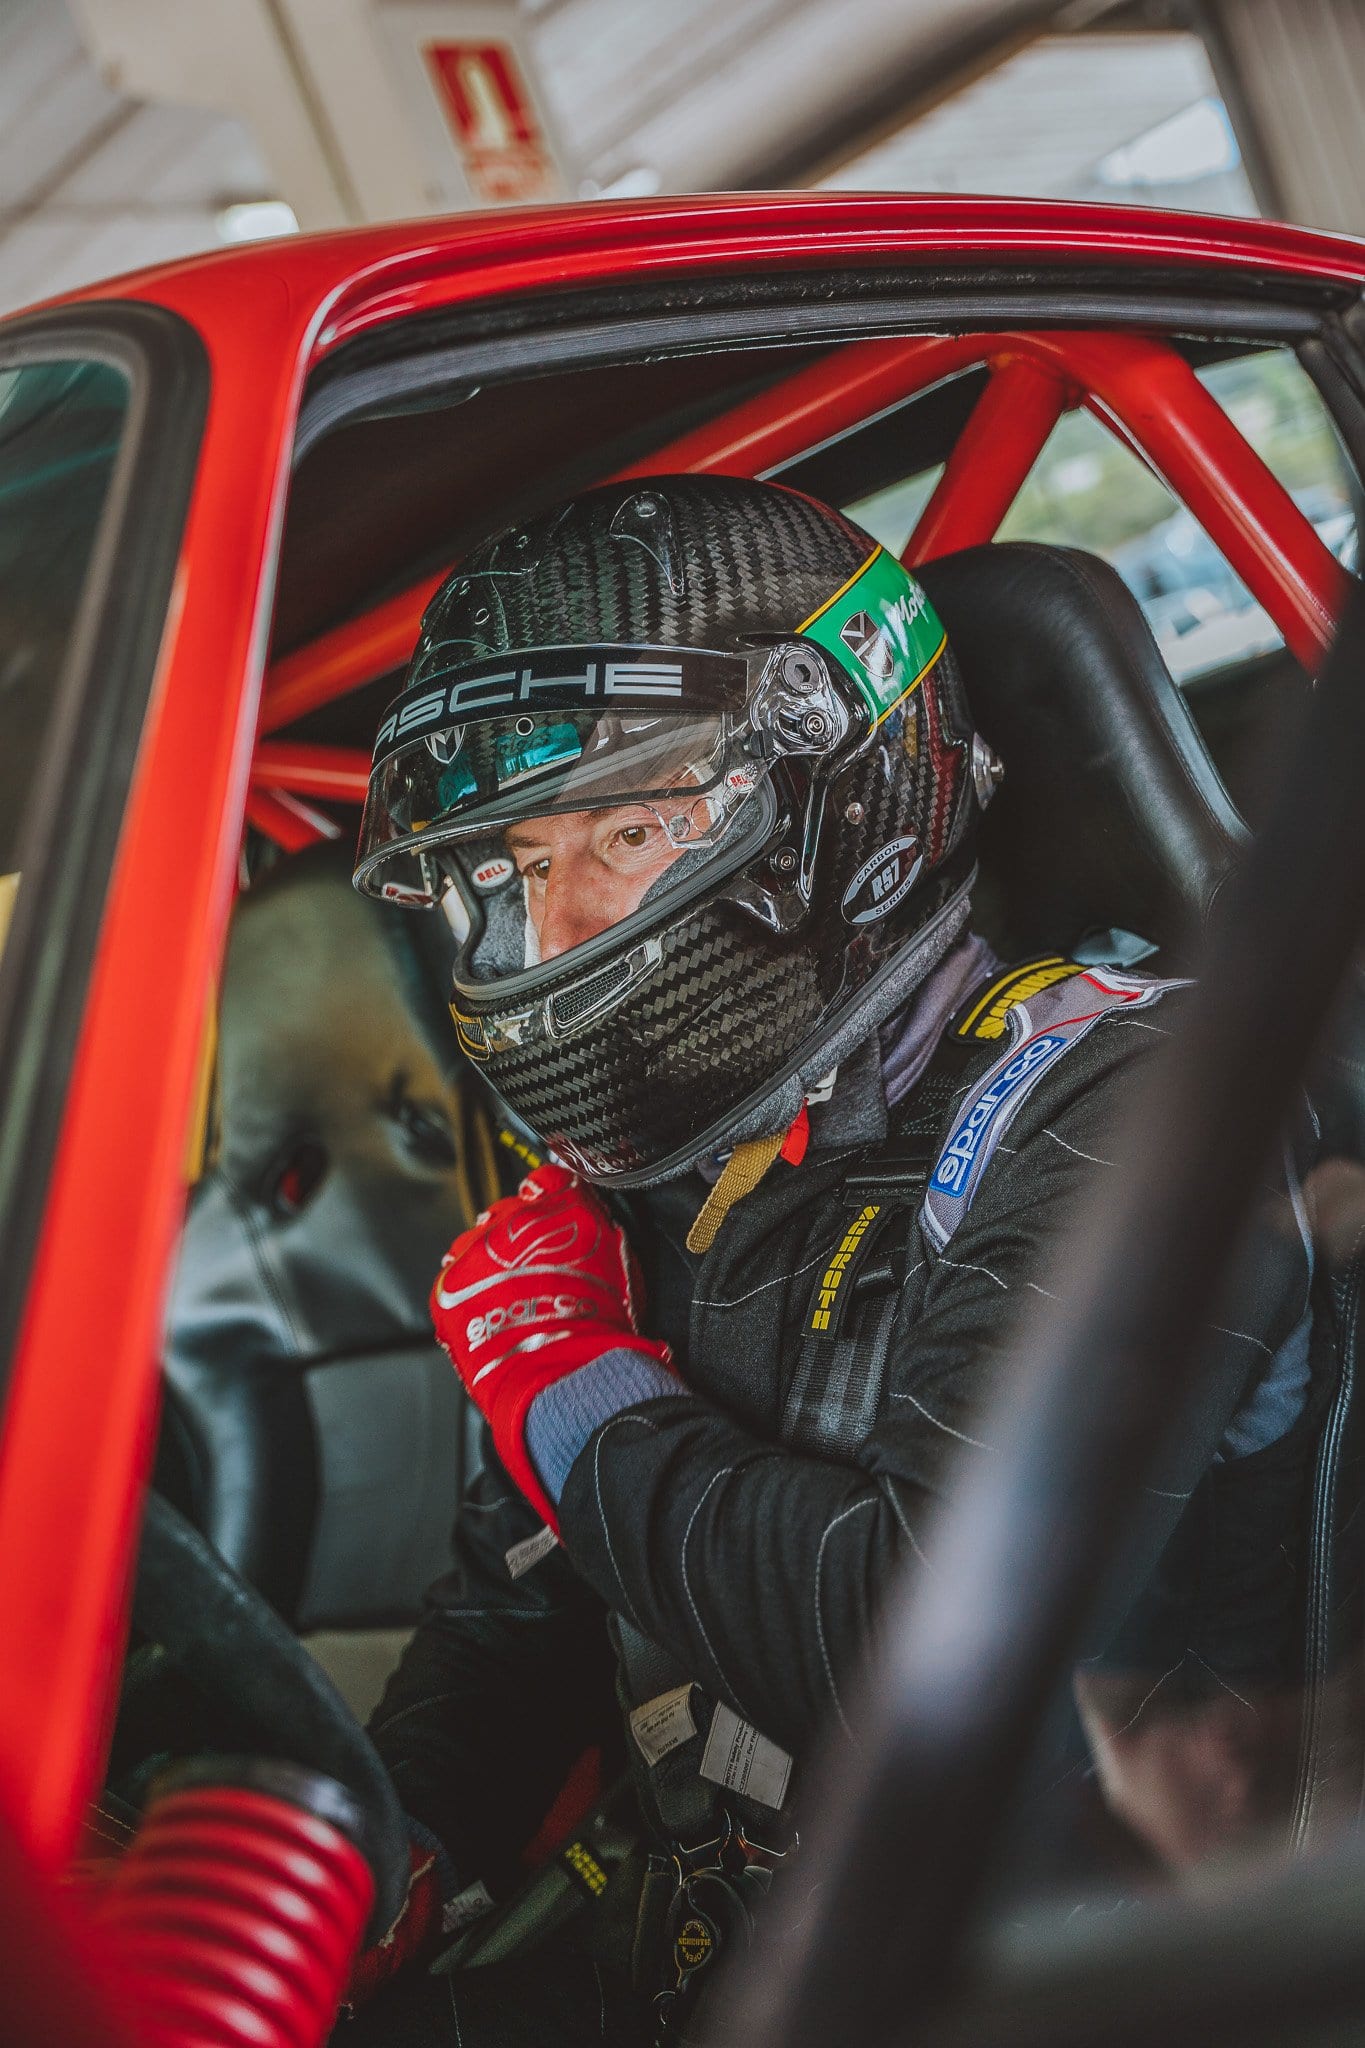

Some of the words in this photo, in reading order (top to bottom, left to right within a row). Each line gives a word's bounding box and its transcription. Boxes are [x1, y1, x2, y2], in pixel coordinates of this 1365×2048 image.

[476, 862, 508, 882] BELL
[856, 842, 900, 884] CARBON
[871, 857, 900, 902] RS7
[875, 880, 911, 915] SERIES
[937, 1037, 1056, 1192] sparco
[811, 1205, 880, 1331] SCHROTH
[465, 1294, 598, 1353] sparco
